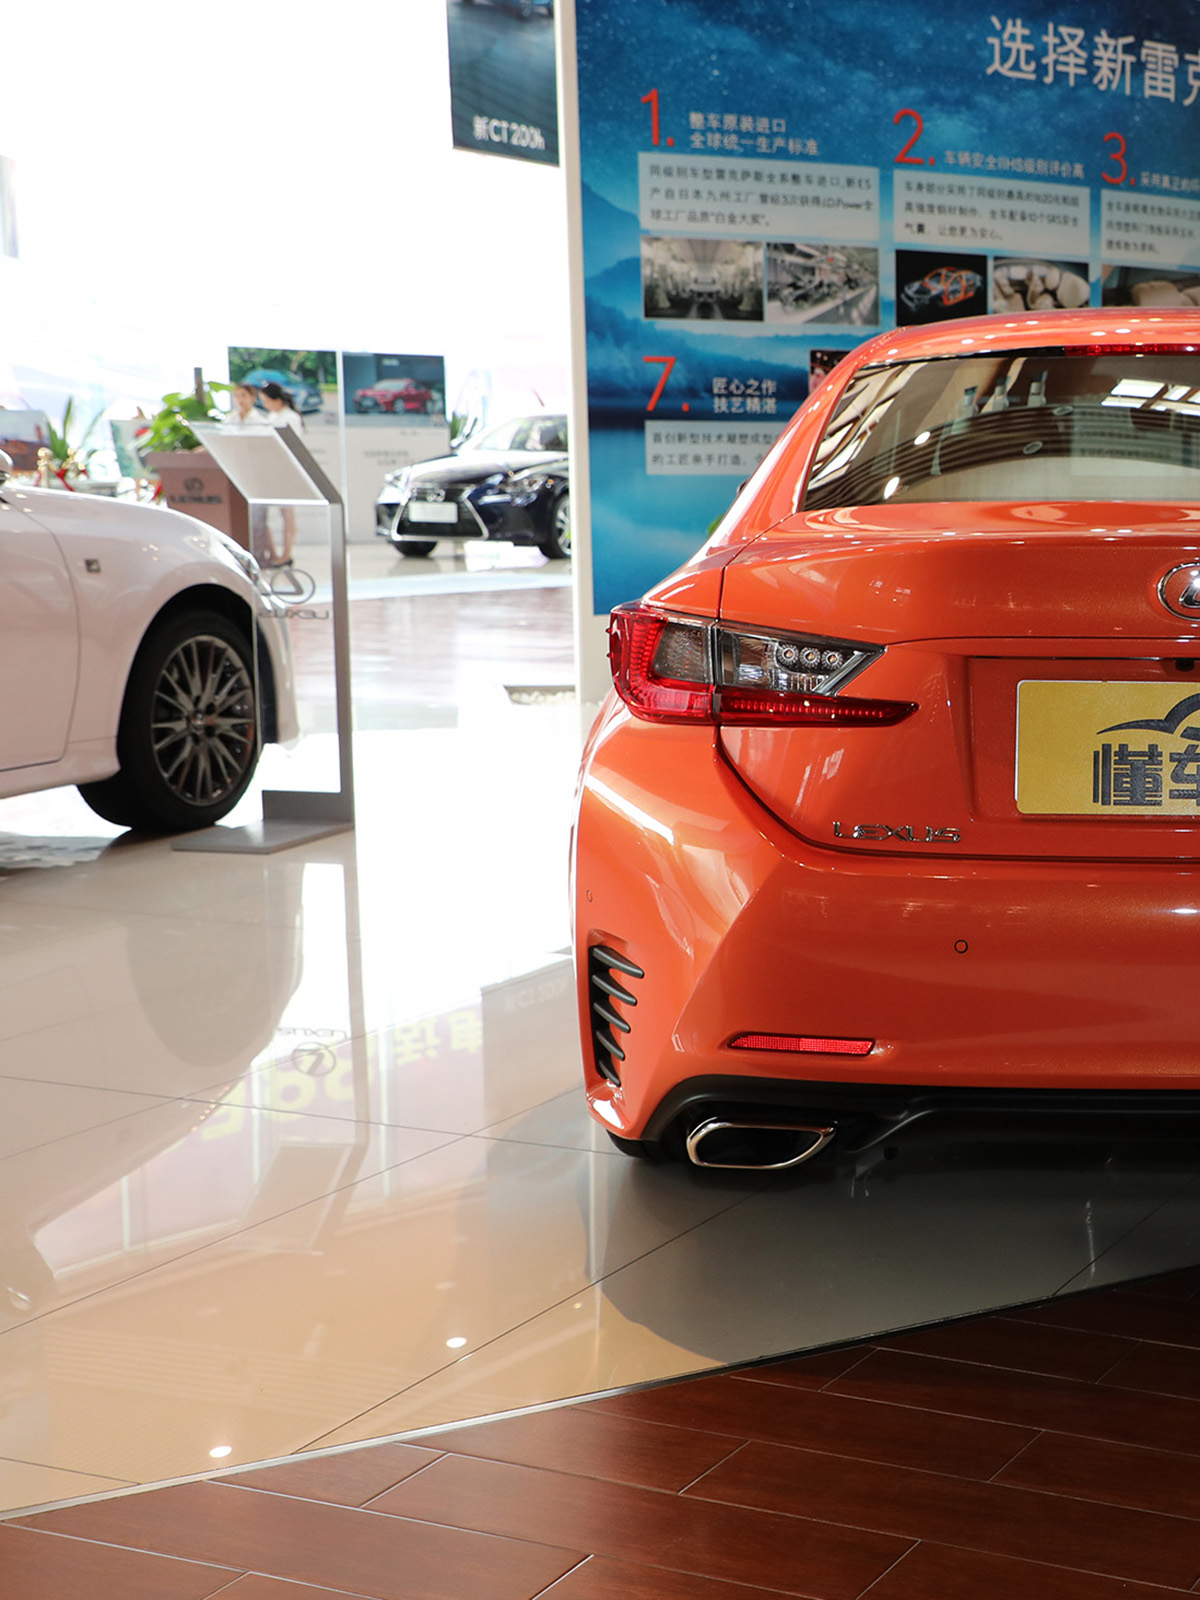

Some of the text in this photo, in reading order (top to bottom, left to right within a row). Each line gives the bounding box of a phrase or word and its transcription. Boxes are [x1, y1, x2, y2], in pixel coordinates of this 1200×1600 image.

[689, 111, 786, 133] 整车原装进口
[690, 131, 820, 156] 全球统一生产标准
[712, 377, 777, 396] 匠心之作
[713, 396, 777, 414] 技艺精湛
[832, 821, 961, 843] LEXUS
